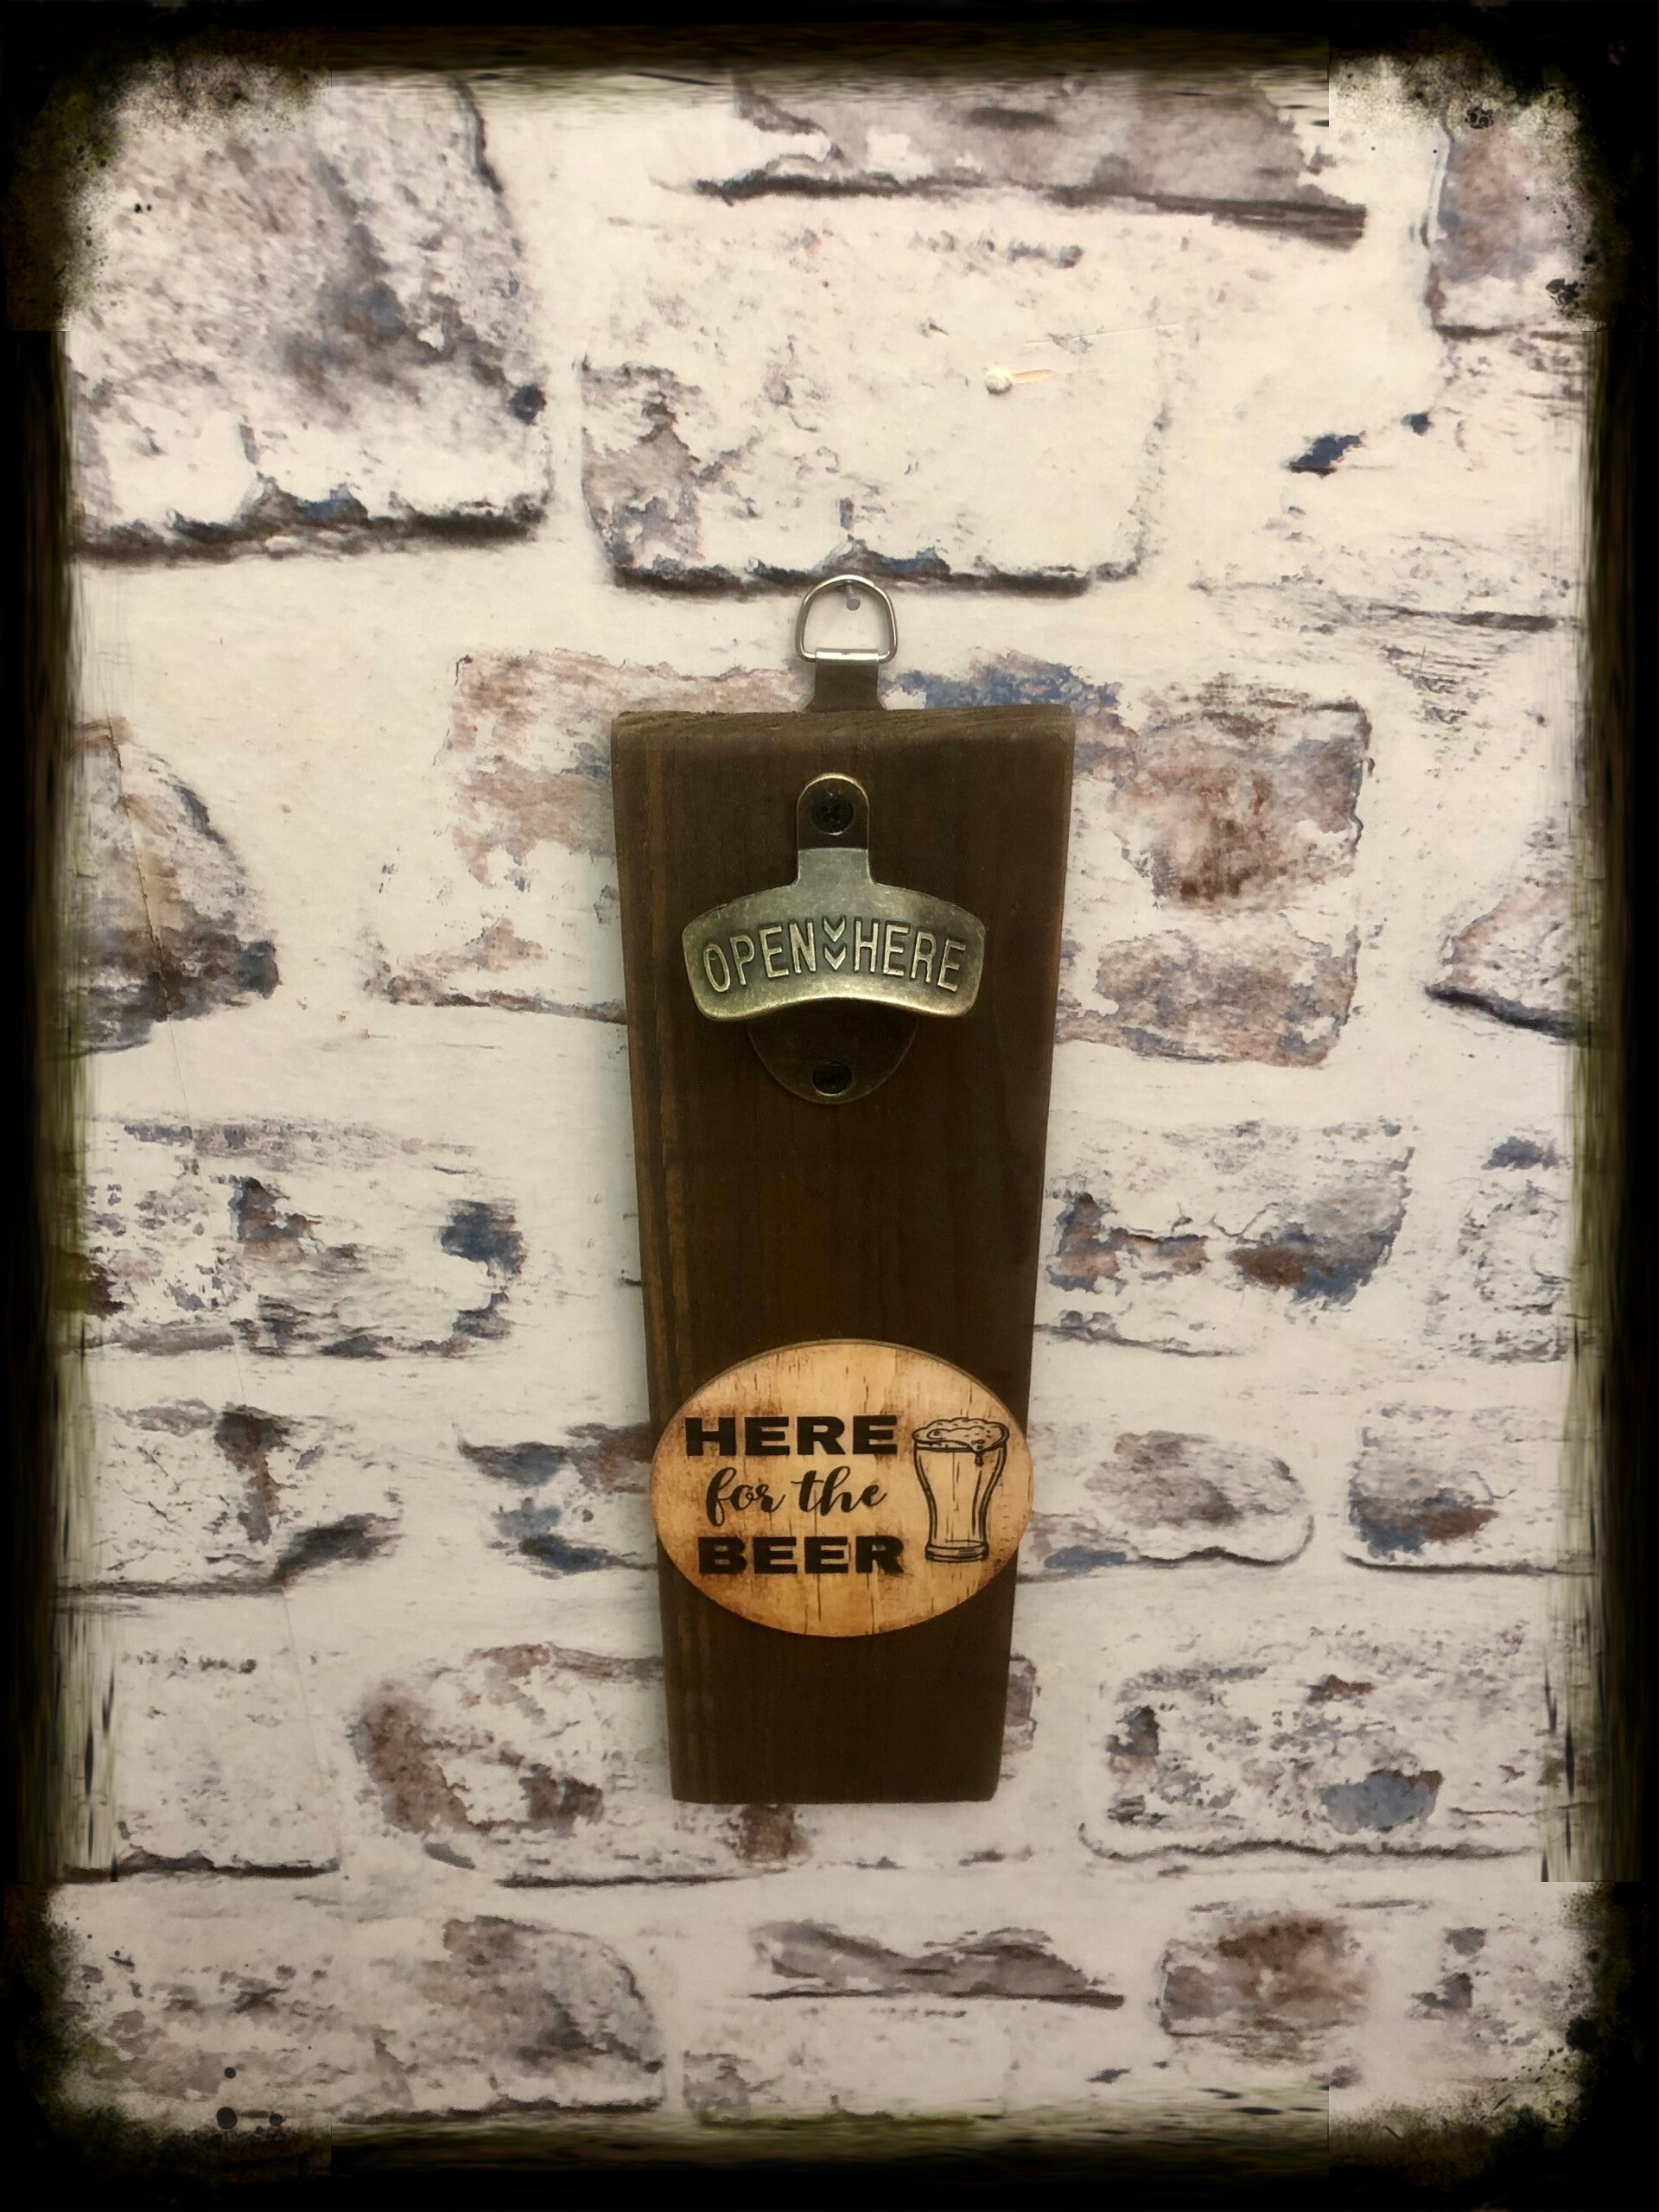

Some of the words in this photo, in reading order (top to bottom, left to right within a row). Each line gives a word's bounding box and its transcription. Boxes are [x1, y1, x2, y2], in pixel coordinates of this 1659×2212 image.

[703, 921, 817, 993] OPEN
[853, 919, 967, 992] HERE
[684, 1414, 898, 1457] HERE
[705, 1466, 785, 1527] for
[791, 1465, 887, 1516] the
[697, 1535, 906, 1574] BEER
